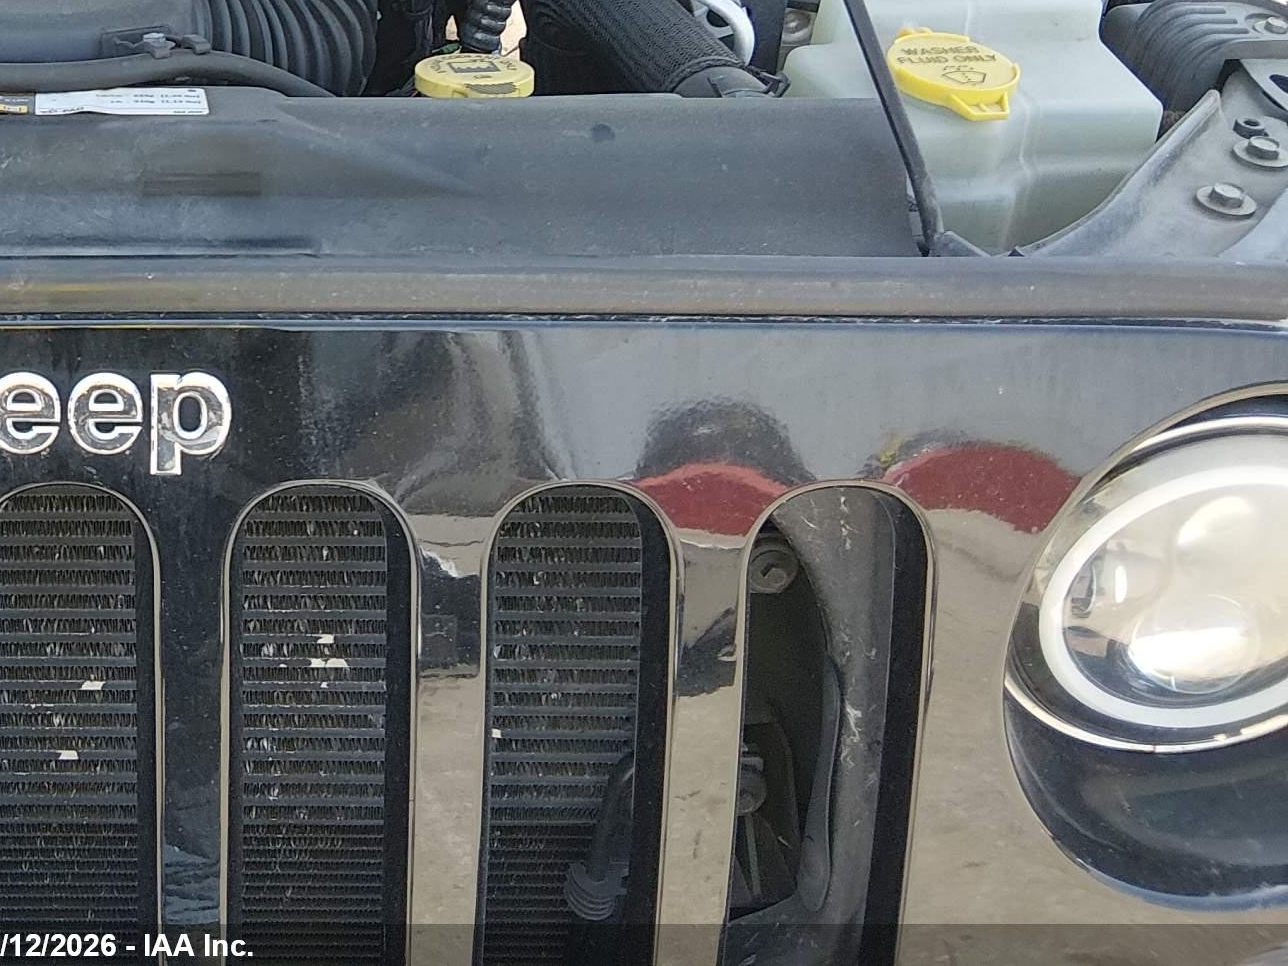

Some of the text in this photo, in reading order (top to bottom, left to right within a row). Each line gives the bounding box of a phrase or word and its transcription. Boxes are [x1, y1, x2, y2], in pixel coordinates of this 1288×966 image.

[900, 45, 980, 55] WASHER
[896, 54, 997, 64] FLUID ONLY
